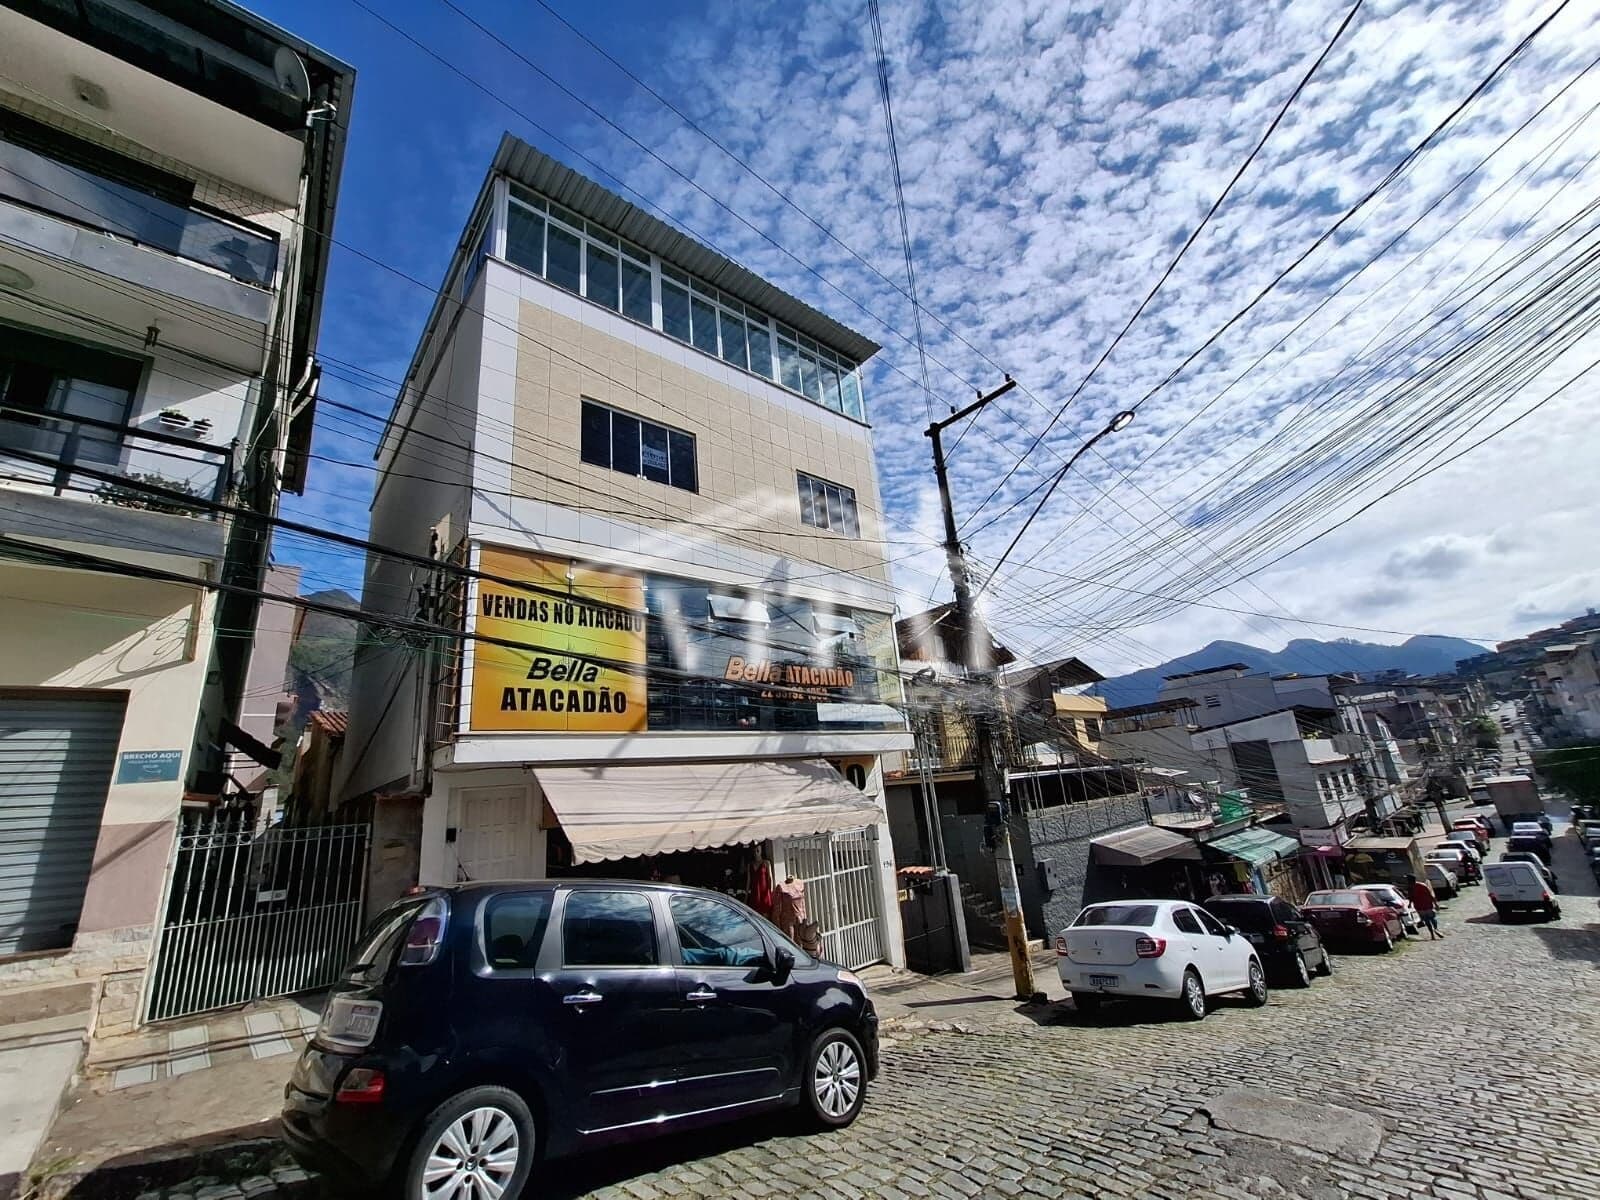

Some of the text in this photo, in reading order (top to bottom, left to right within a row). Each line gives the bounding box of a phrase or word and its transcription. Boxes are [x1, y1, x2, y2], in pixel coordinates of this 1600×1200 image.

[482, 593, 643, 633] VENDAS NO ATACADO
[526, 657, 599, 683] Bella
[724, 656, 854, 689] Bella ATACADÃO
[500, 686, 627, 713] ATACADÃO
[159, 751, 181, 760] AQUI
